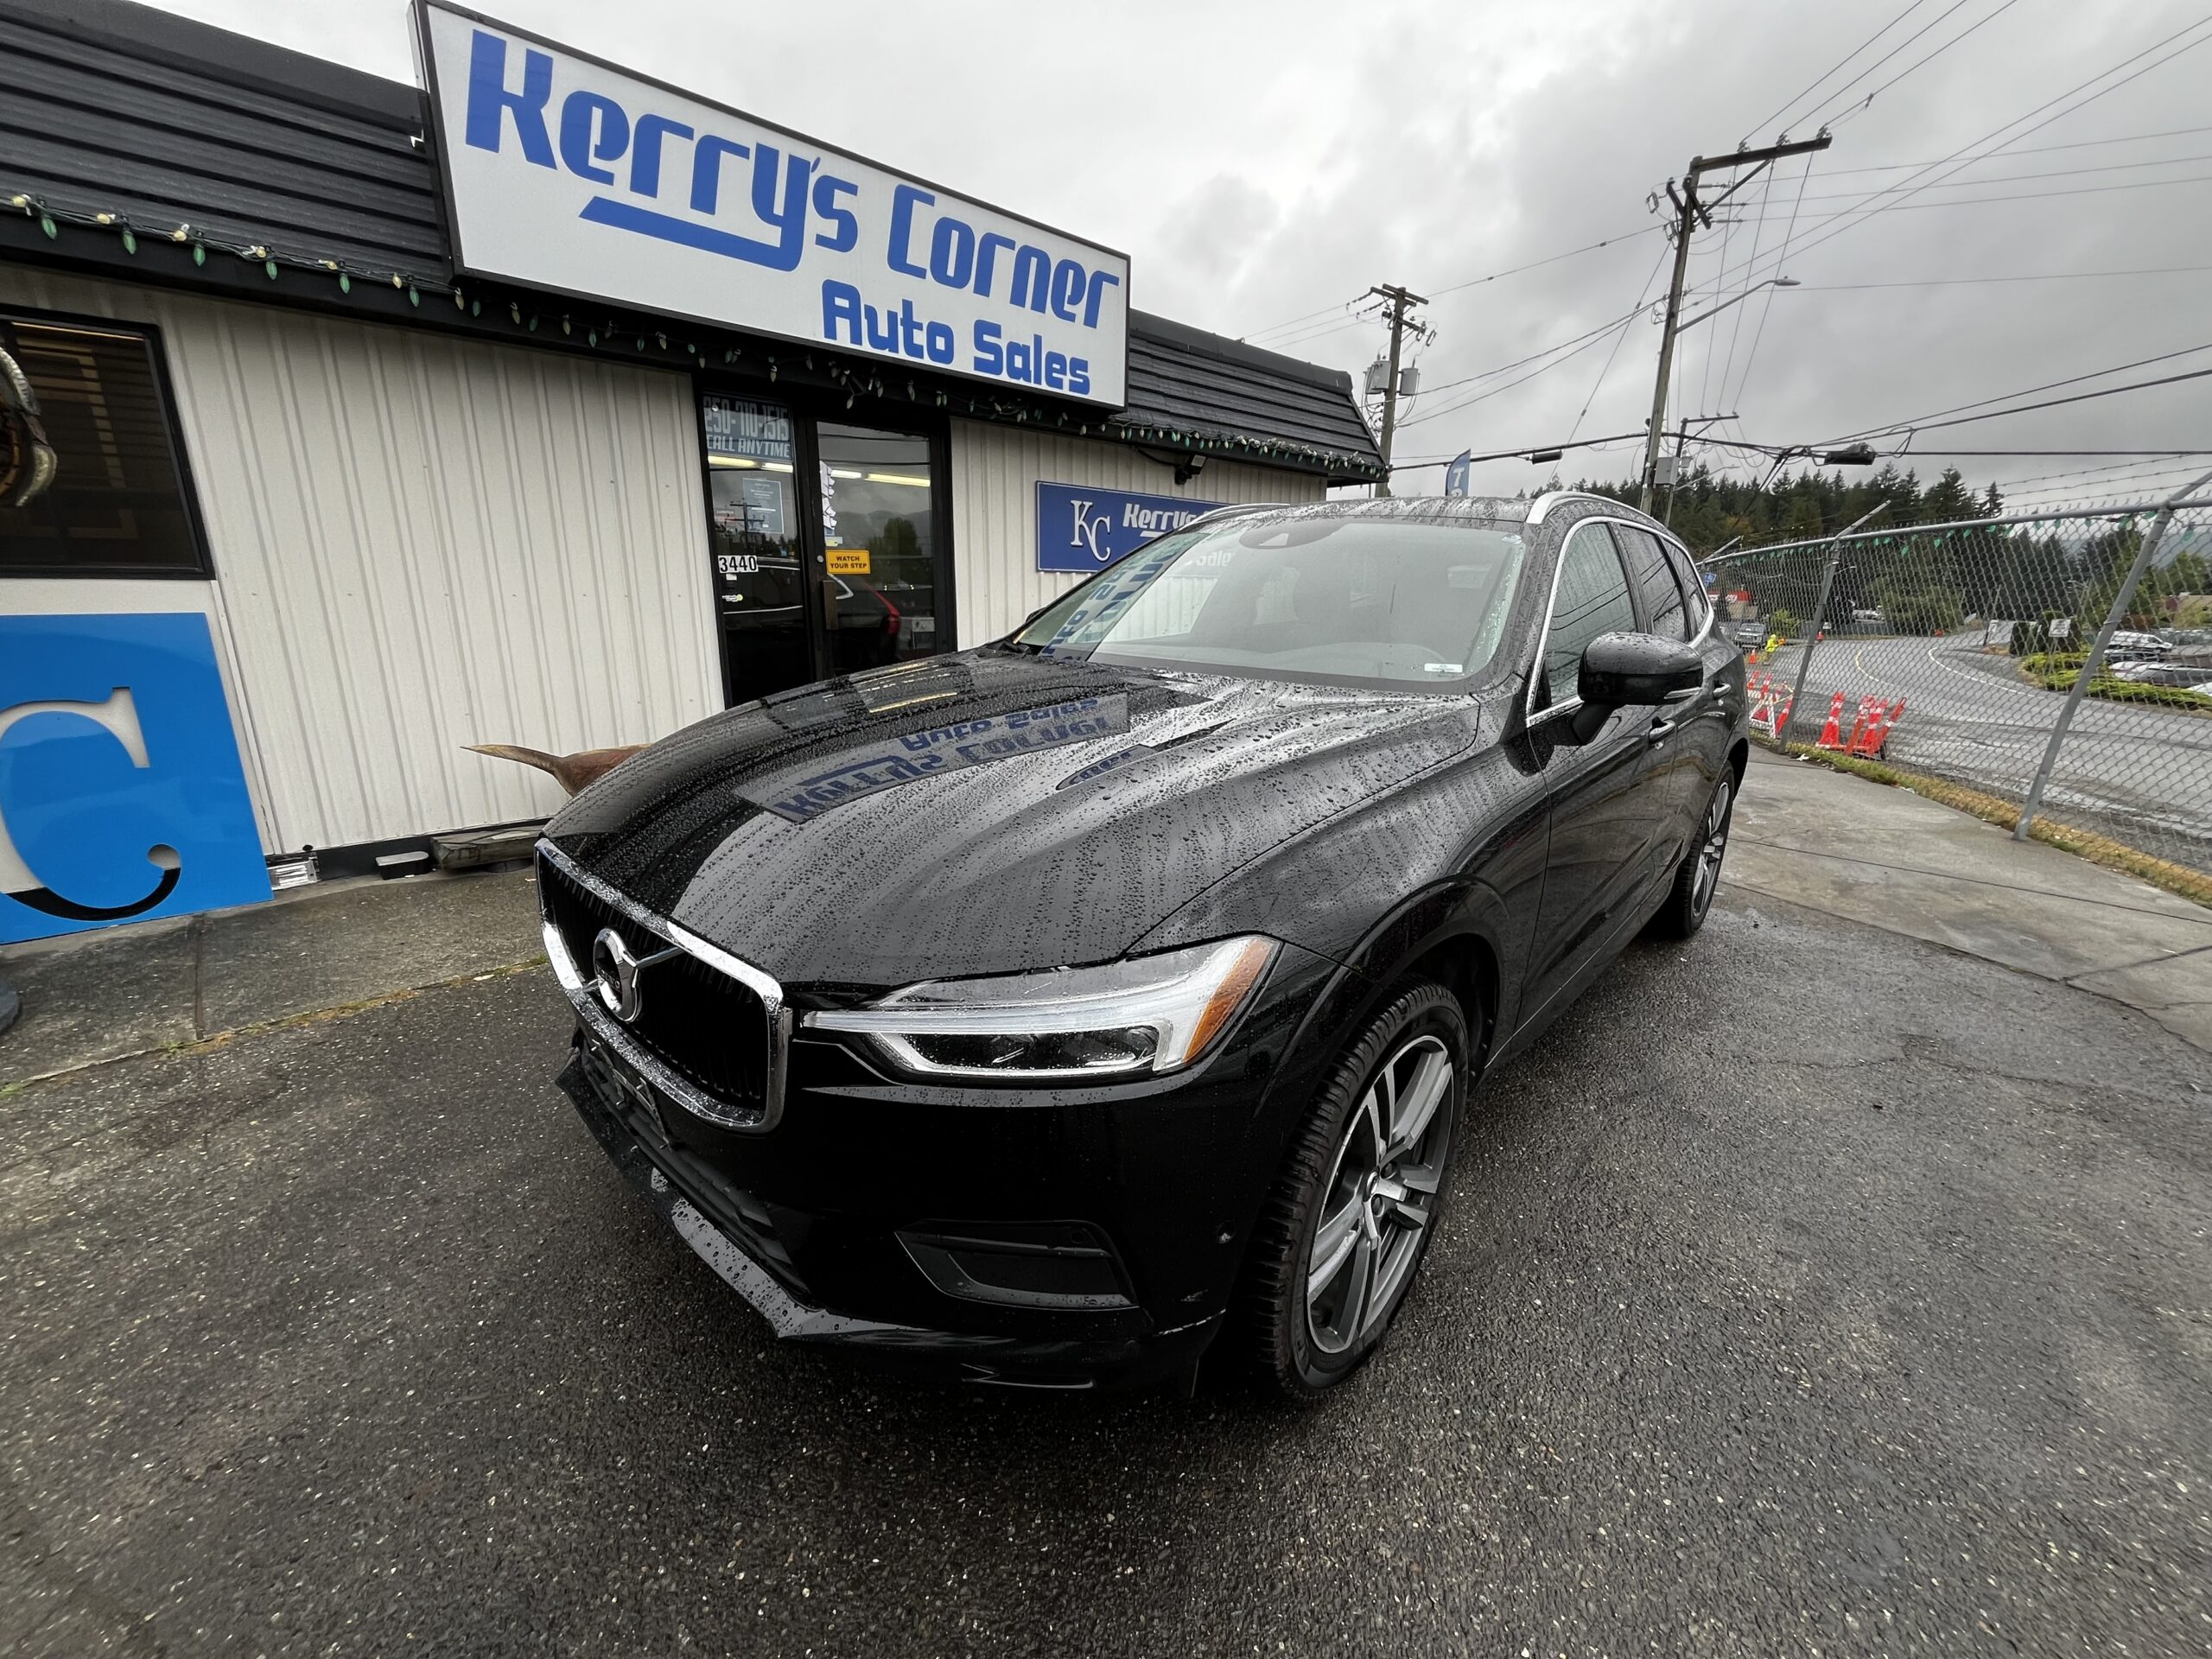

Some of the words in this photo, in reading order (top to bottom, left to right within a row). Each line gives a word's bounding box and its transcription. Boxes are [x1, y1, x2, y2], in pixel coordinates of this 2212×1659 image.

[466, 29, 859, 272] Kerry's
[887, 184, 1120, 329] Corner
[821, 279, 955, 365] Auto
[973, 319, 1090, 395] Sales
[707, 434, 735, 451] CALL
[738, 438, 791, 458] ANYTIME
[1071, 500, 1111, 562] KC
[719, 556, 757, 572] 3440
